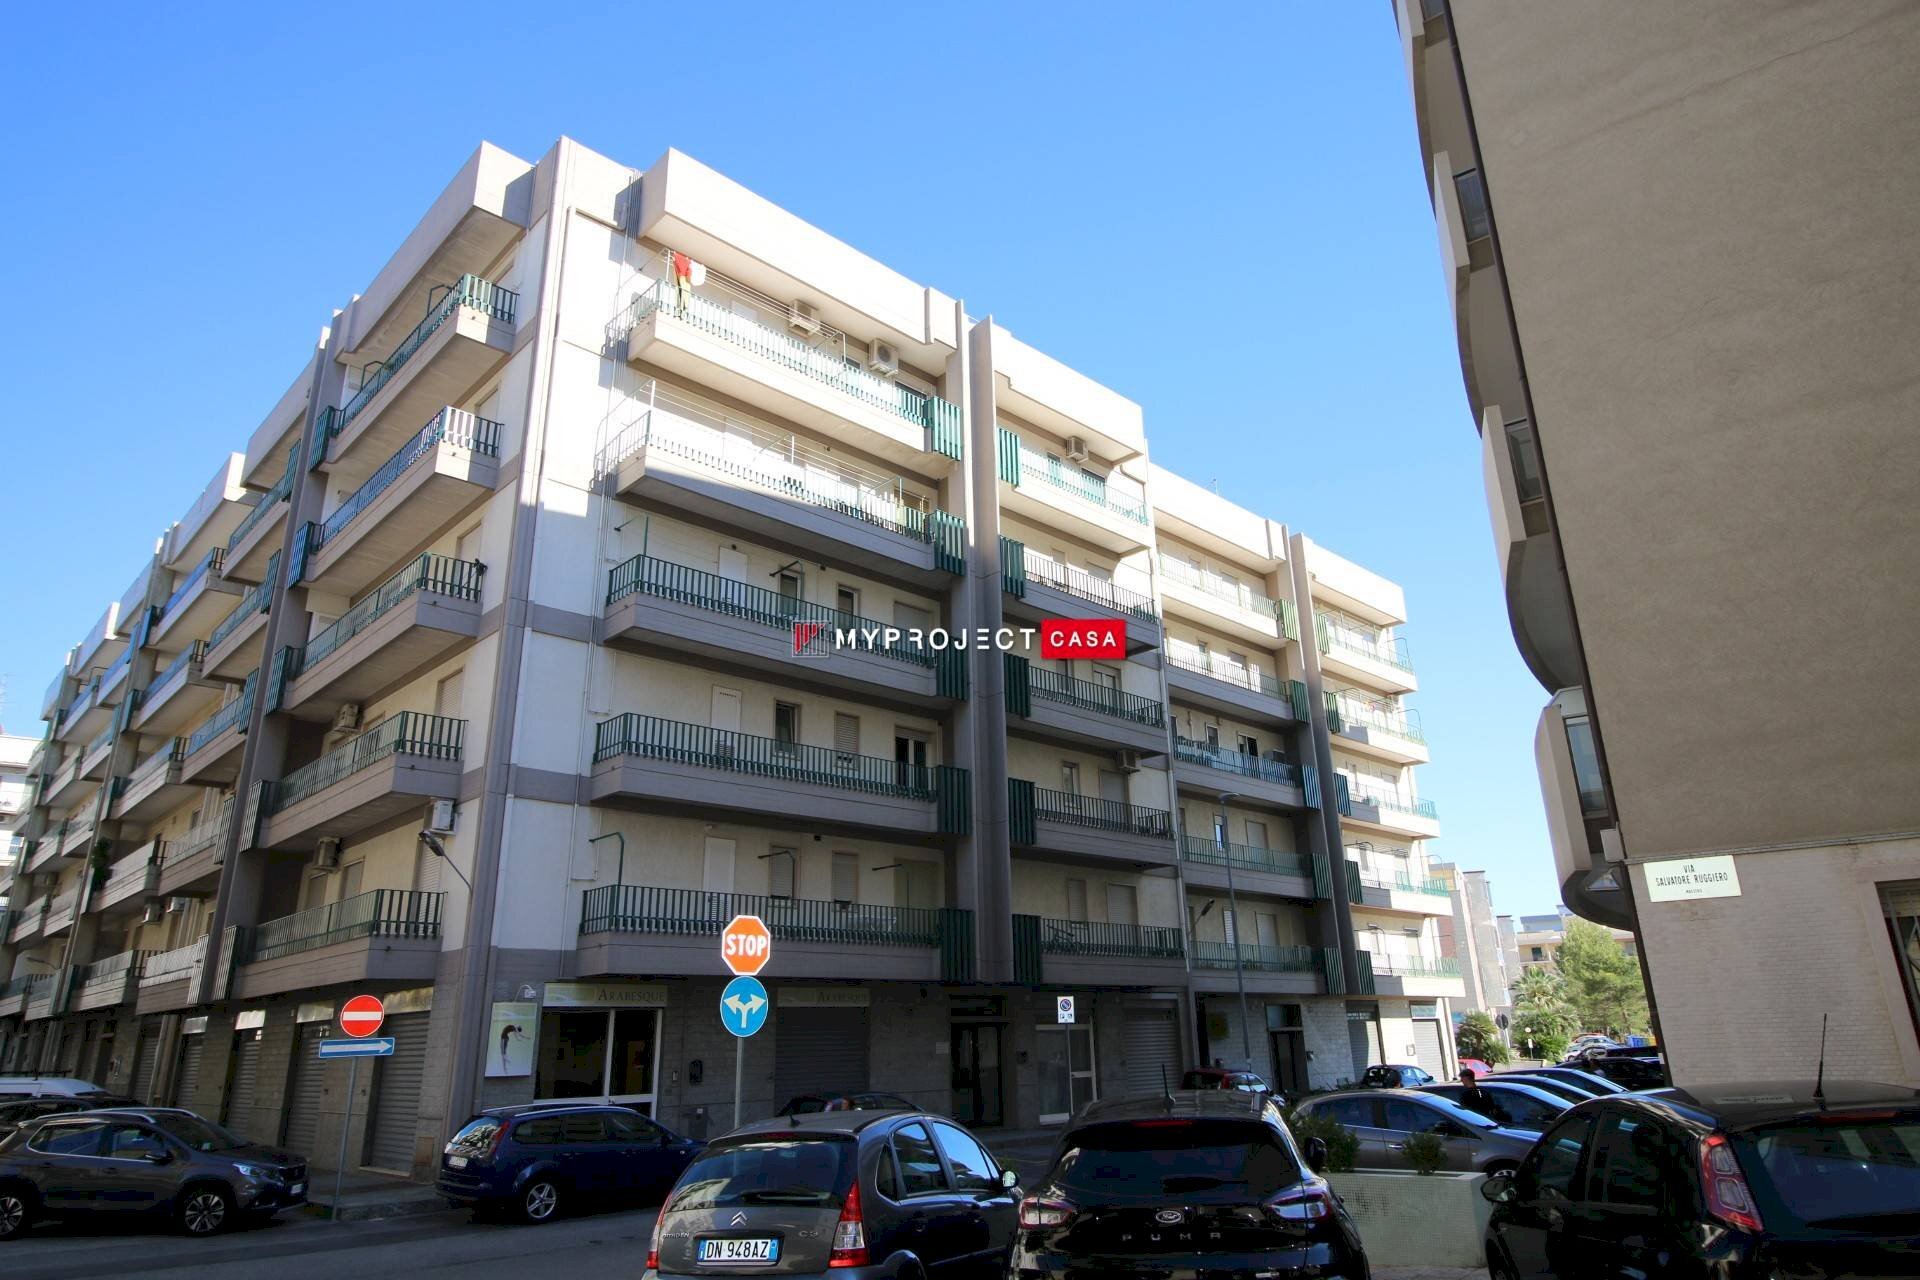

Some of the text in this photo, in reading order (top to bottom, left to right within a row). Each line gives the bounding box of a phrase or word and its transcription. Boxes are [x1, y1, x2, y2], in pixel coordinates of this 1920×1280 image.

[1683, 864, 1695, 873] VIA
[1655, 872, 1729, 887] SALVATORE RUGGIERO
[725, 934, 768, 957] STOP
[598, 988, 665, 1003] ARABESQUE
[1122, 1232, 1221, 1241] PUMA
[706, 1241, 723, 1259] DN
[727, 1241, 769, 1259] 948AZ
